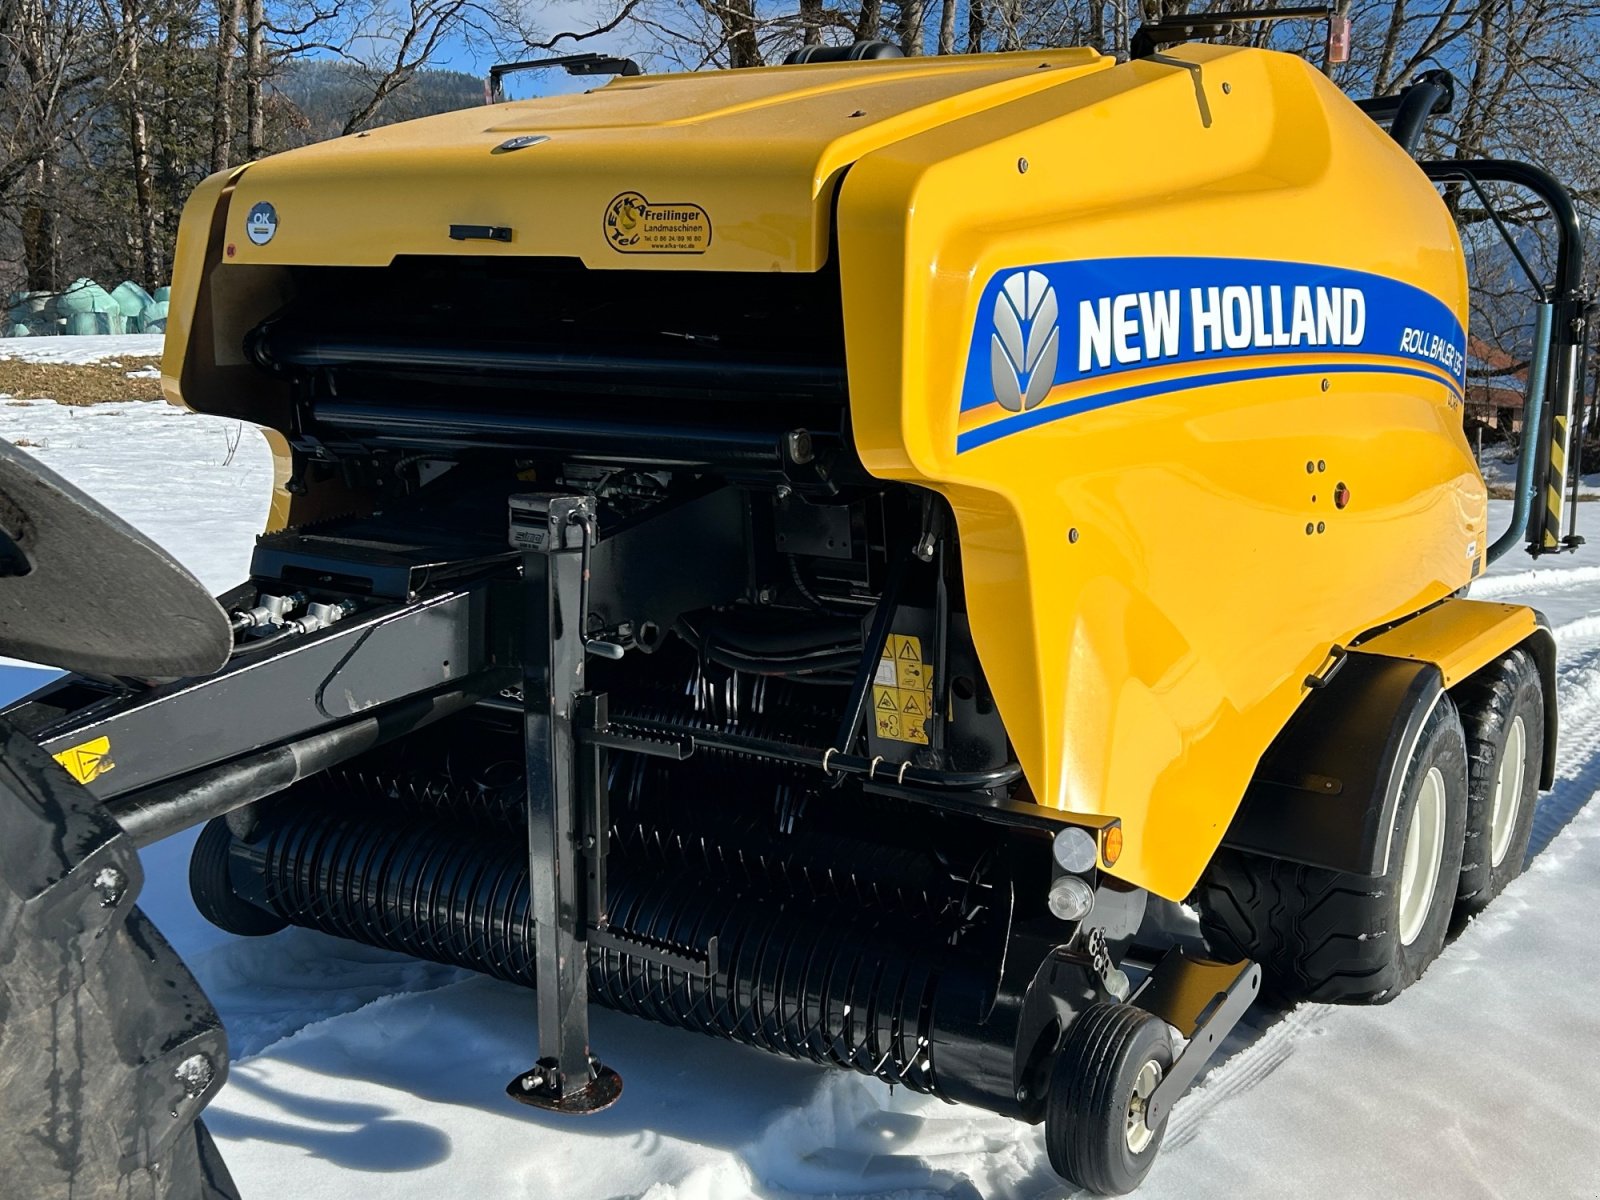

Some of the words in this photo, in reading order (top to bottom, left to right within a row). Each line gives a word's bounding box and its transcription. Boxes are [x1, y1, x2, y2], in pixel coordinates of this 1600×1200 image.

[254, 212, 270, 224] OK
[644, 210, 700, 222] Freilinger
[643, 224, 703, 232] Landmaschinen
[1078, 289, 1180, 372] NEW
[1190, 285, 1366, 353] HOLLAND
